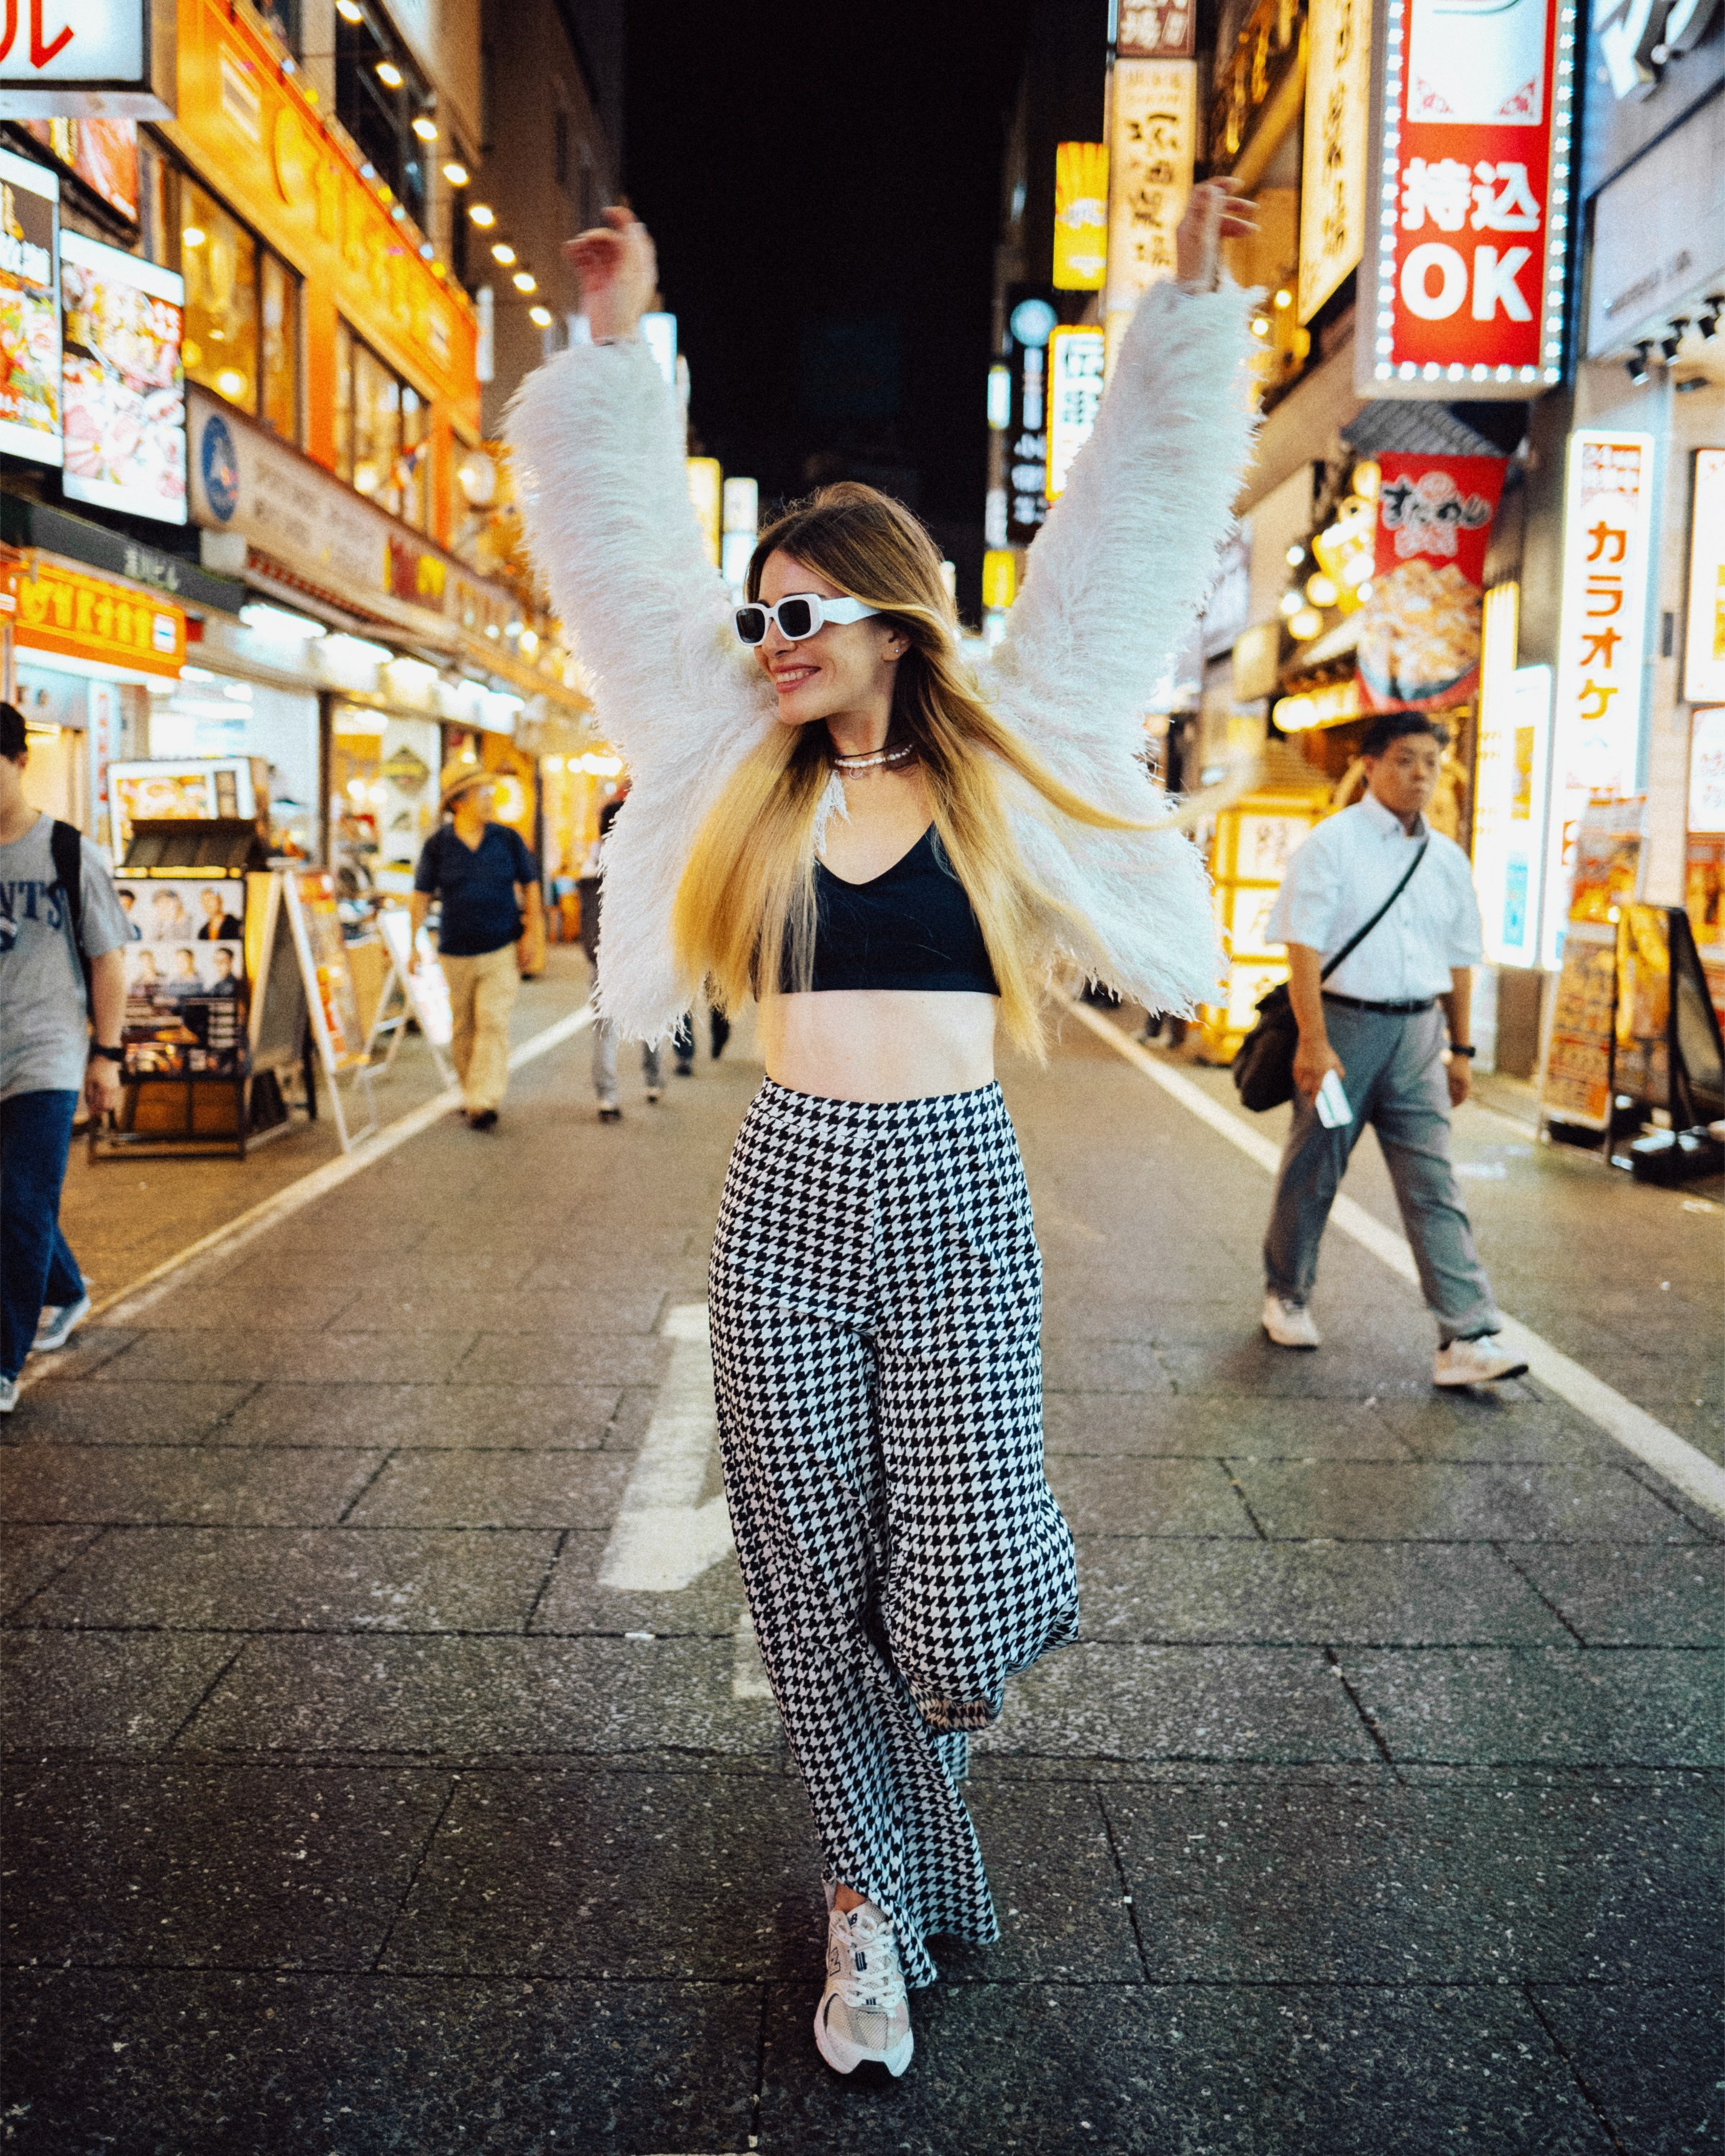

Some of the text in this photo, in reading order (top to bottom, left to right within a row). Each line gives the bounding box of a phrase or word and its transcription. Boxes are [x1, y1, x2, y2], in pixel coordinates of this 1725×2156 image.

[1401, 157, 1541, 232] 持込
[1400, 242, 1533, 321] OK
[1578, 520, 1627, 720] カラオケ
